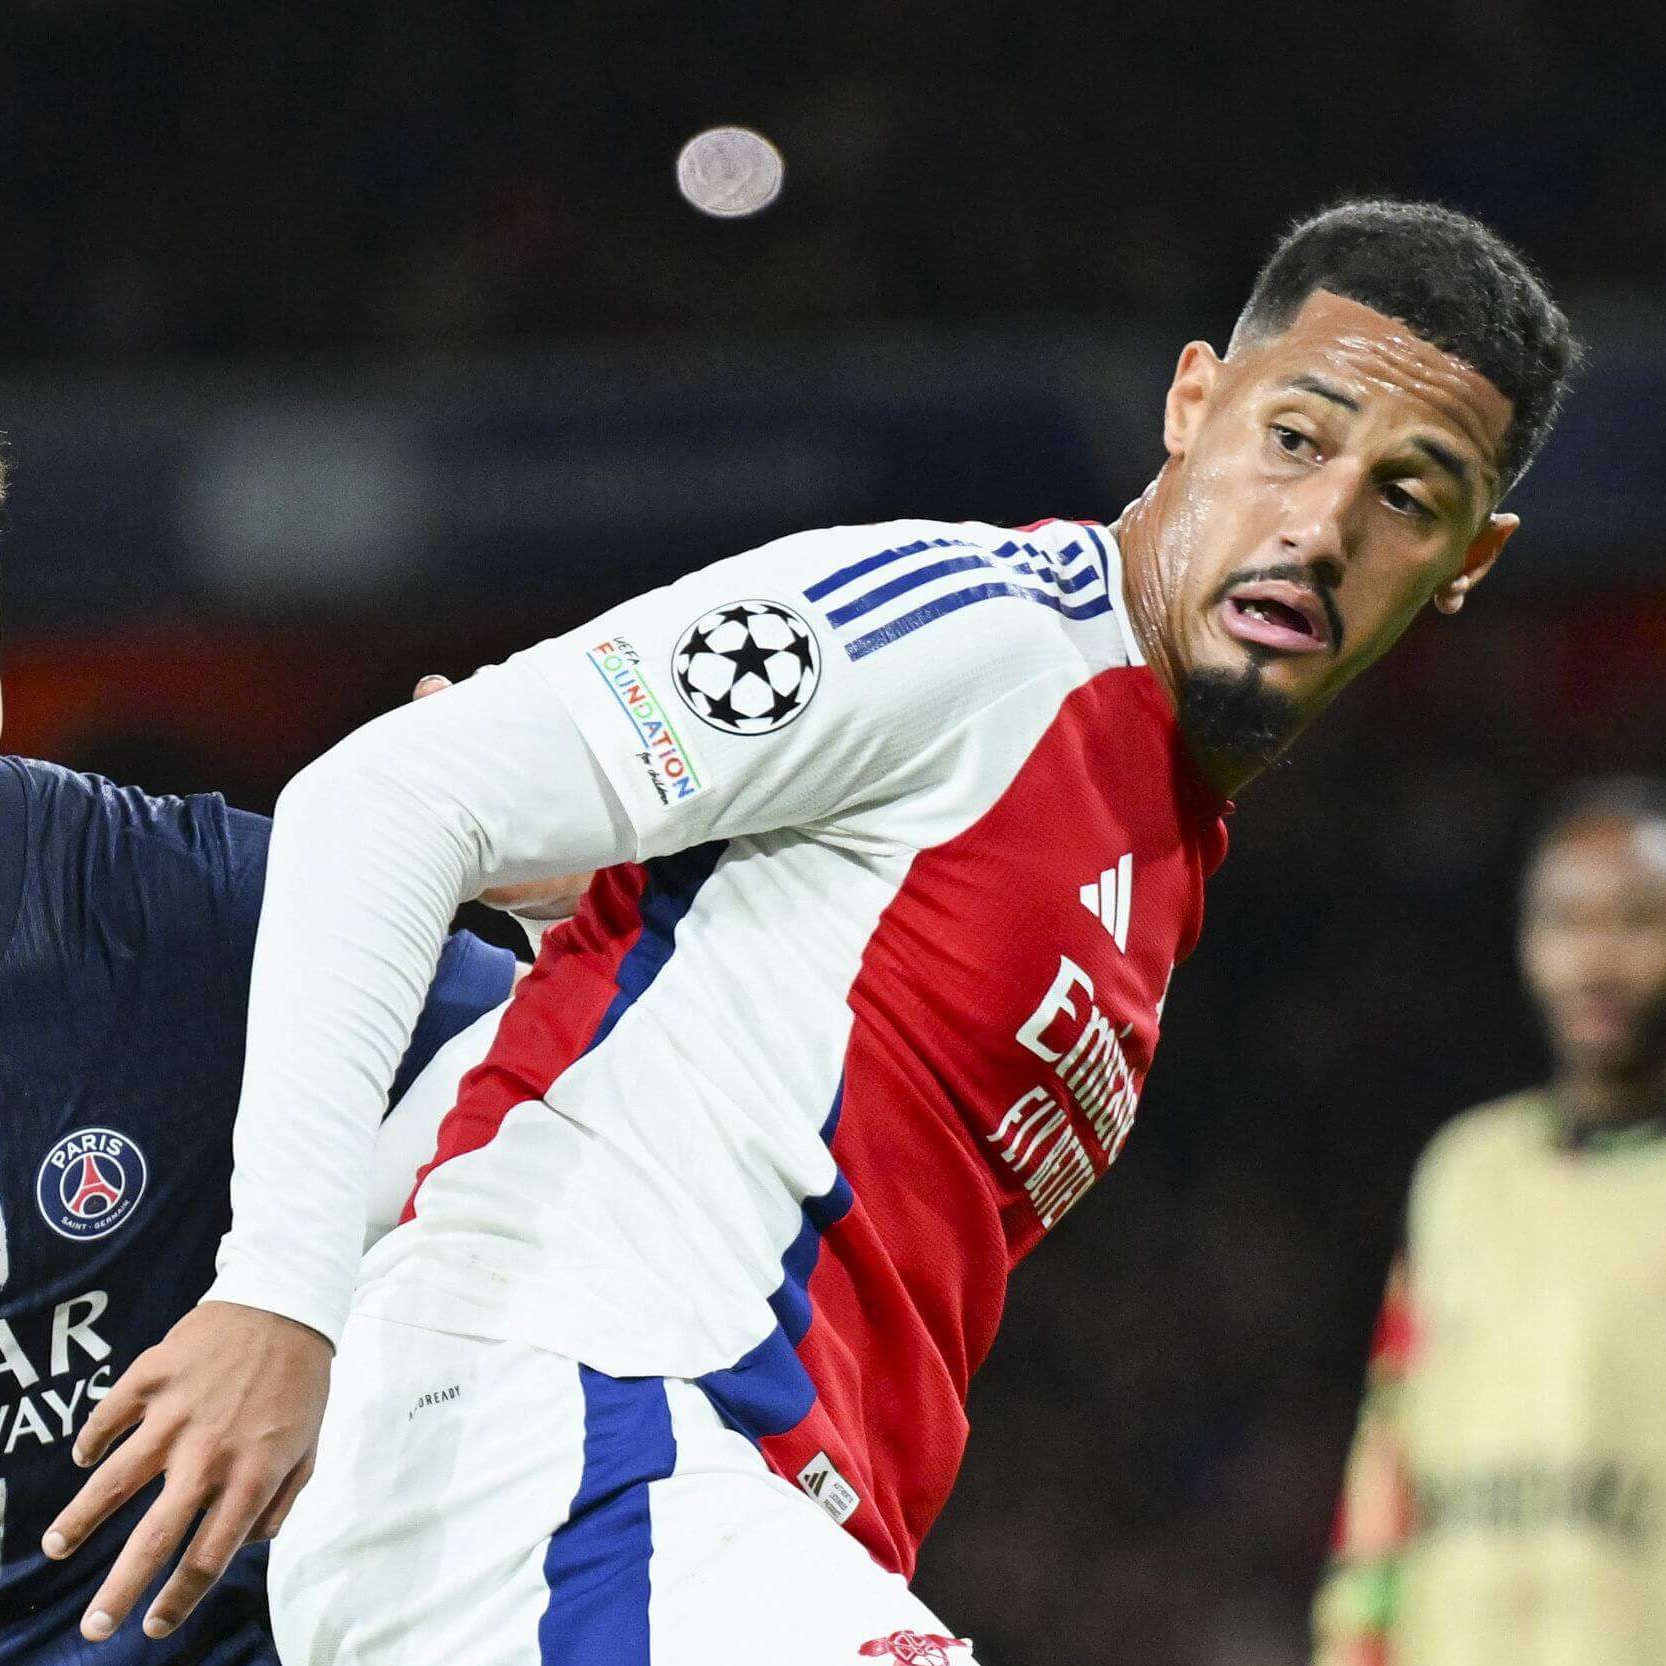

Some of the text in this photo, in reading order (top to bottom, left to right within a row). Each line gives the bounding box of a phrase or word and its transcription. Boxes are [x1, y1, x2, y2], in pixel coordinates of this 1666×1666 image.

[613, 636, 640, 665] UEFA
[1015, 954, 1137, 1165] Emirate
[986, 1085, 1067, 1173] FLY
[51, 1134, 123, 1169] PARIS
[61, 1199, 130, 1231] SAINT GERMAIN
